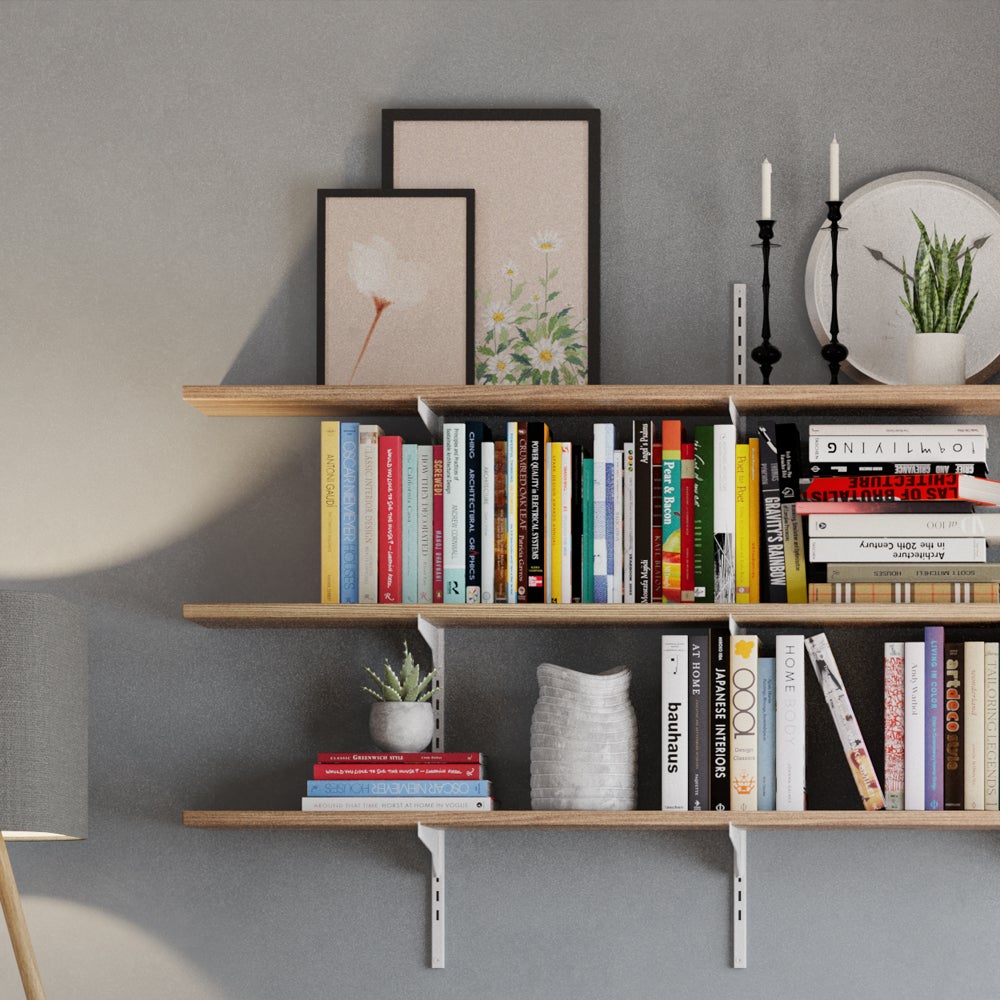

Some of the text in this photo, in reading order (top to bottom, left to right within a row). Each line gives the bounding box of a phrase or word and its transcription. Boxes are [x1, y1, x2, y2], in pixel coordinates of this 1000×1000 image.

[640, 423, 648, 442] Psalms
[343, 440, 356, 482] OSCAR
[519, 438, 527, 487] CRUMBLED
[531, 440, 539, 460] POWER
[326, 454, 337, 482] ANTONI
[434, 459, 443, 496] SCREWED!
[530, 462, 539, 488] QUALITY
[362, 478, 372, 513] INTERIOR
[421, 477, 429, 501] THEY
[519, 487, 527, 506] OAK
[663, 461, 675, 525] Pear & Bacon
[531, 494, 539, 531] ELECTRICAL
[362, 515, 372, 544] DESIGN
[421, 503, 429, 557] DECORATED
[764, 496, 786, 586] GRAVITY'S RAINBOW
[531, 532, 539, 560] SYSTEMS
[859, 540, 945, 550] in the 20th Century
[892, 552, 945, 560] Architecture
[343, 543, 356, 590] HOUSES
[692, 643, 701, 696] AT HOME
[909, 663, 918, 684] Andy
[931, 670, 937, 679] IN
[785, 645, 796, 746] HOME BODY
[715, 667, 726, 779] JAPANESE INTERIORS
[986, 661, 998, 796] TAILORING LEGENDS
[667, 702, 682, 774] bauhaus
[734, 747, 754, 755] Design
[325, 783, 370, 794] HOUSES
[428, 783, 469, 794] OSCAR
